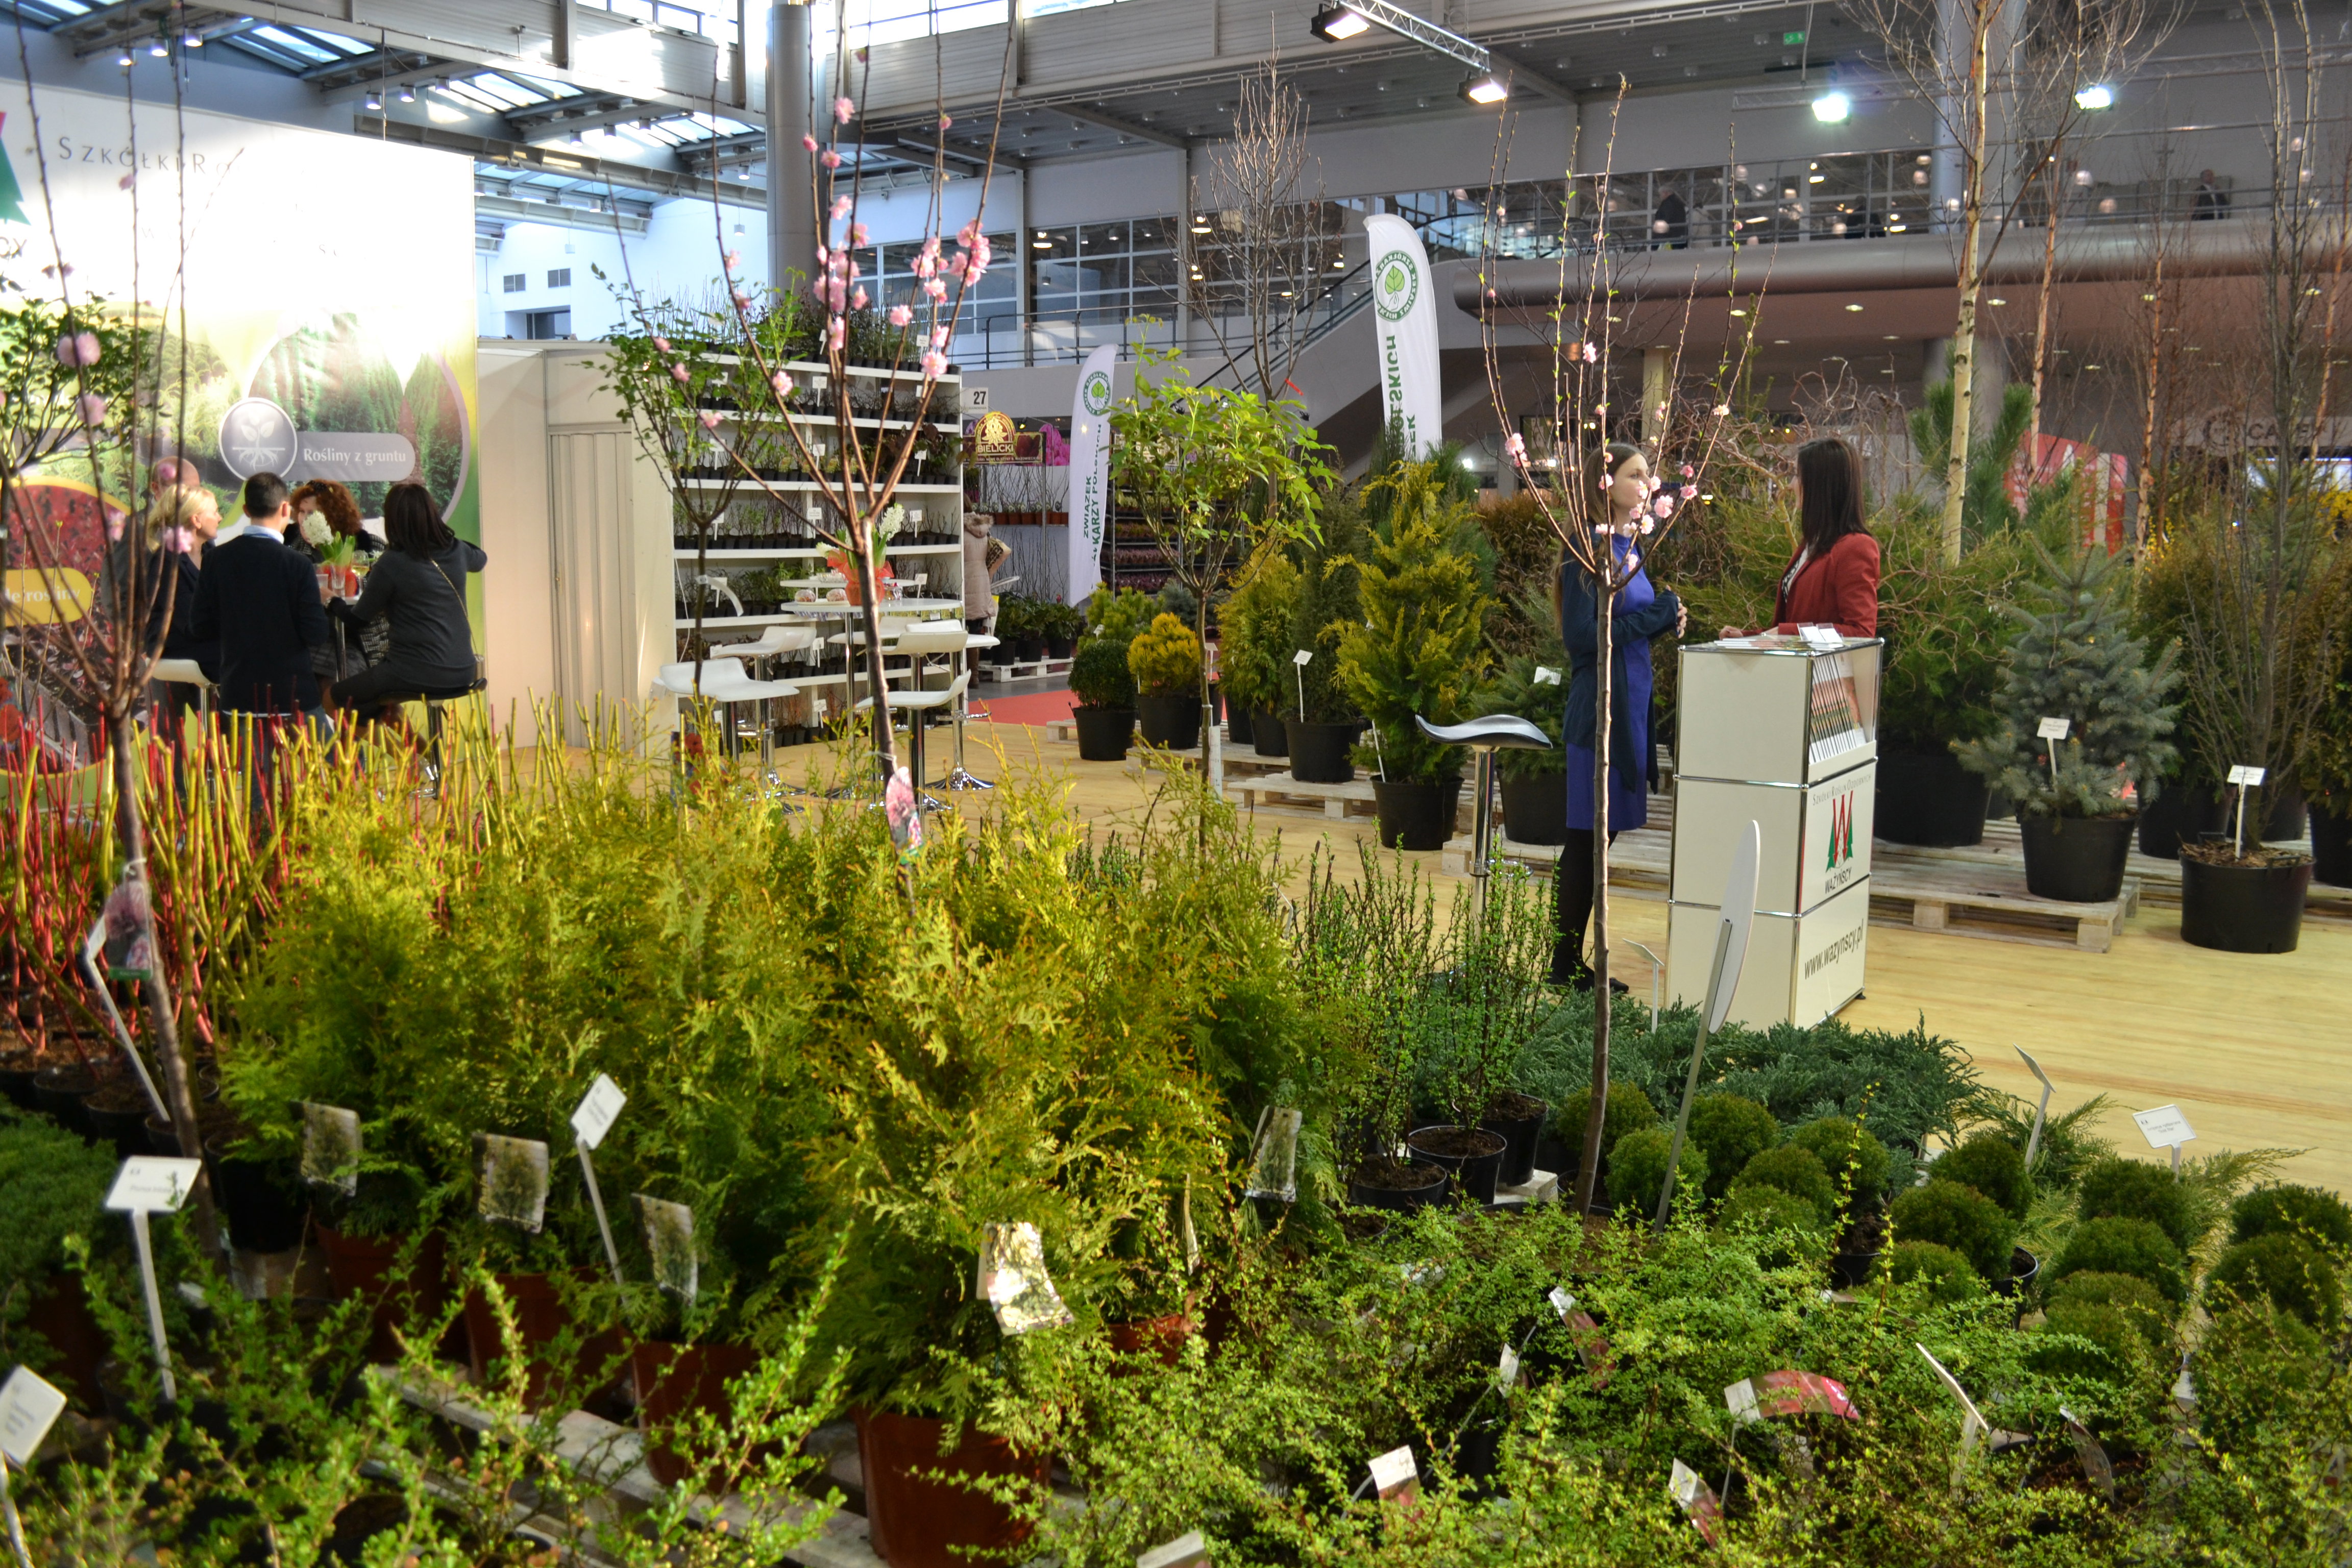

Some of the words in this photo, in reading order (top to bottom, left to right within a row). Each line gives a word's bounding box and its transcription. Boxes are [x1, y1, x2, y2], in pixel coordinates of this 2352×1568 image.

[973, 391, 987, 405] 27
[304, 448, 351, 466] Rośliny
[355, 452, 362, 461] z
[365, 450, 406, 465] gruntu
[977, 444, 1013, 453] BIELICKI
[1083, 476, 1092, 538] ZWIĄZEK
[1825, 867, 1852, 894] WAŻYŃSCY
[1805, 918, 1864, 980] www.wazynscy.pl
